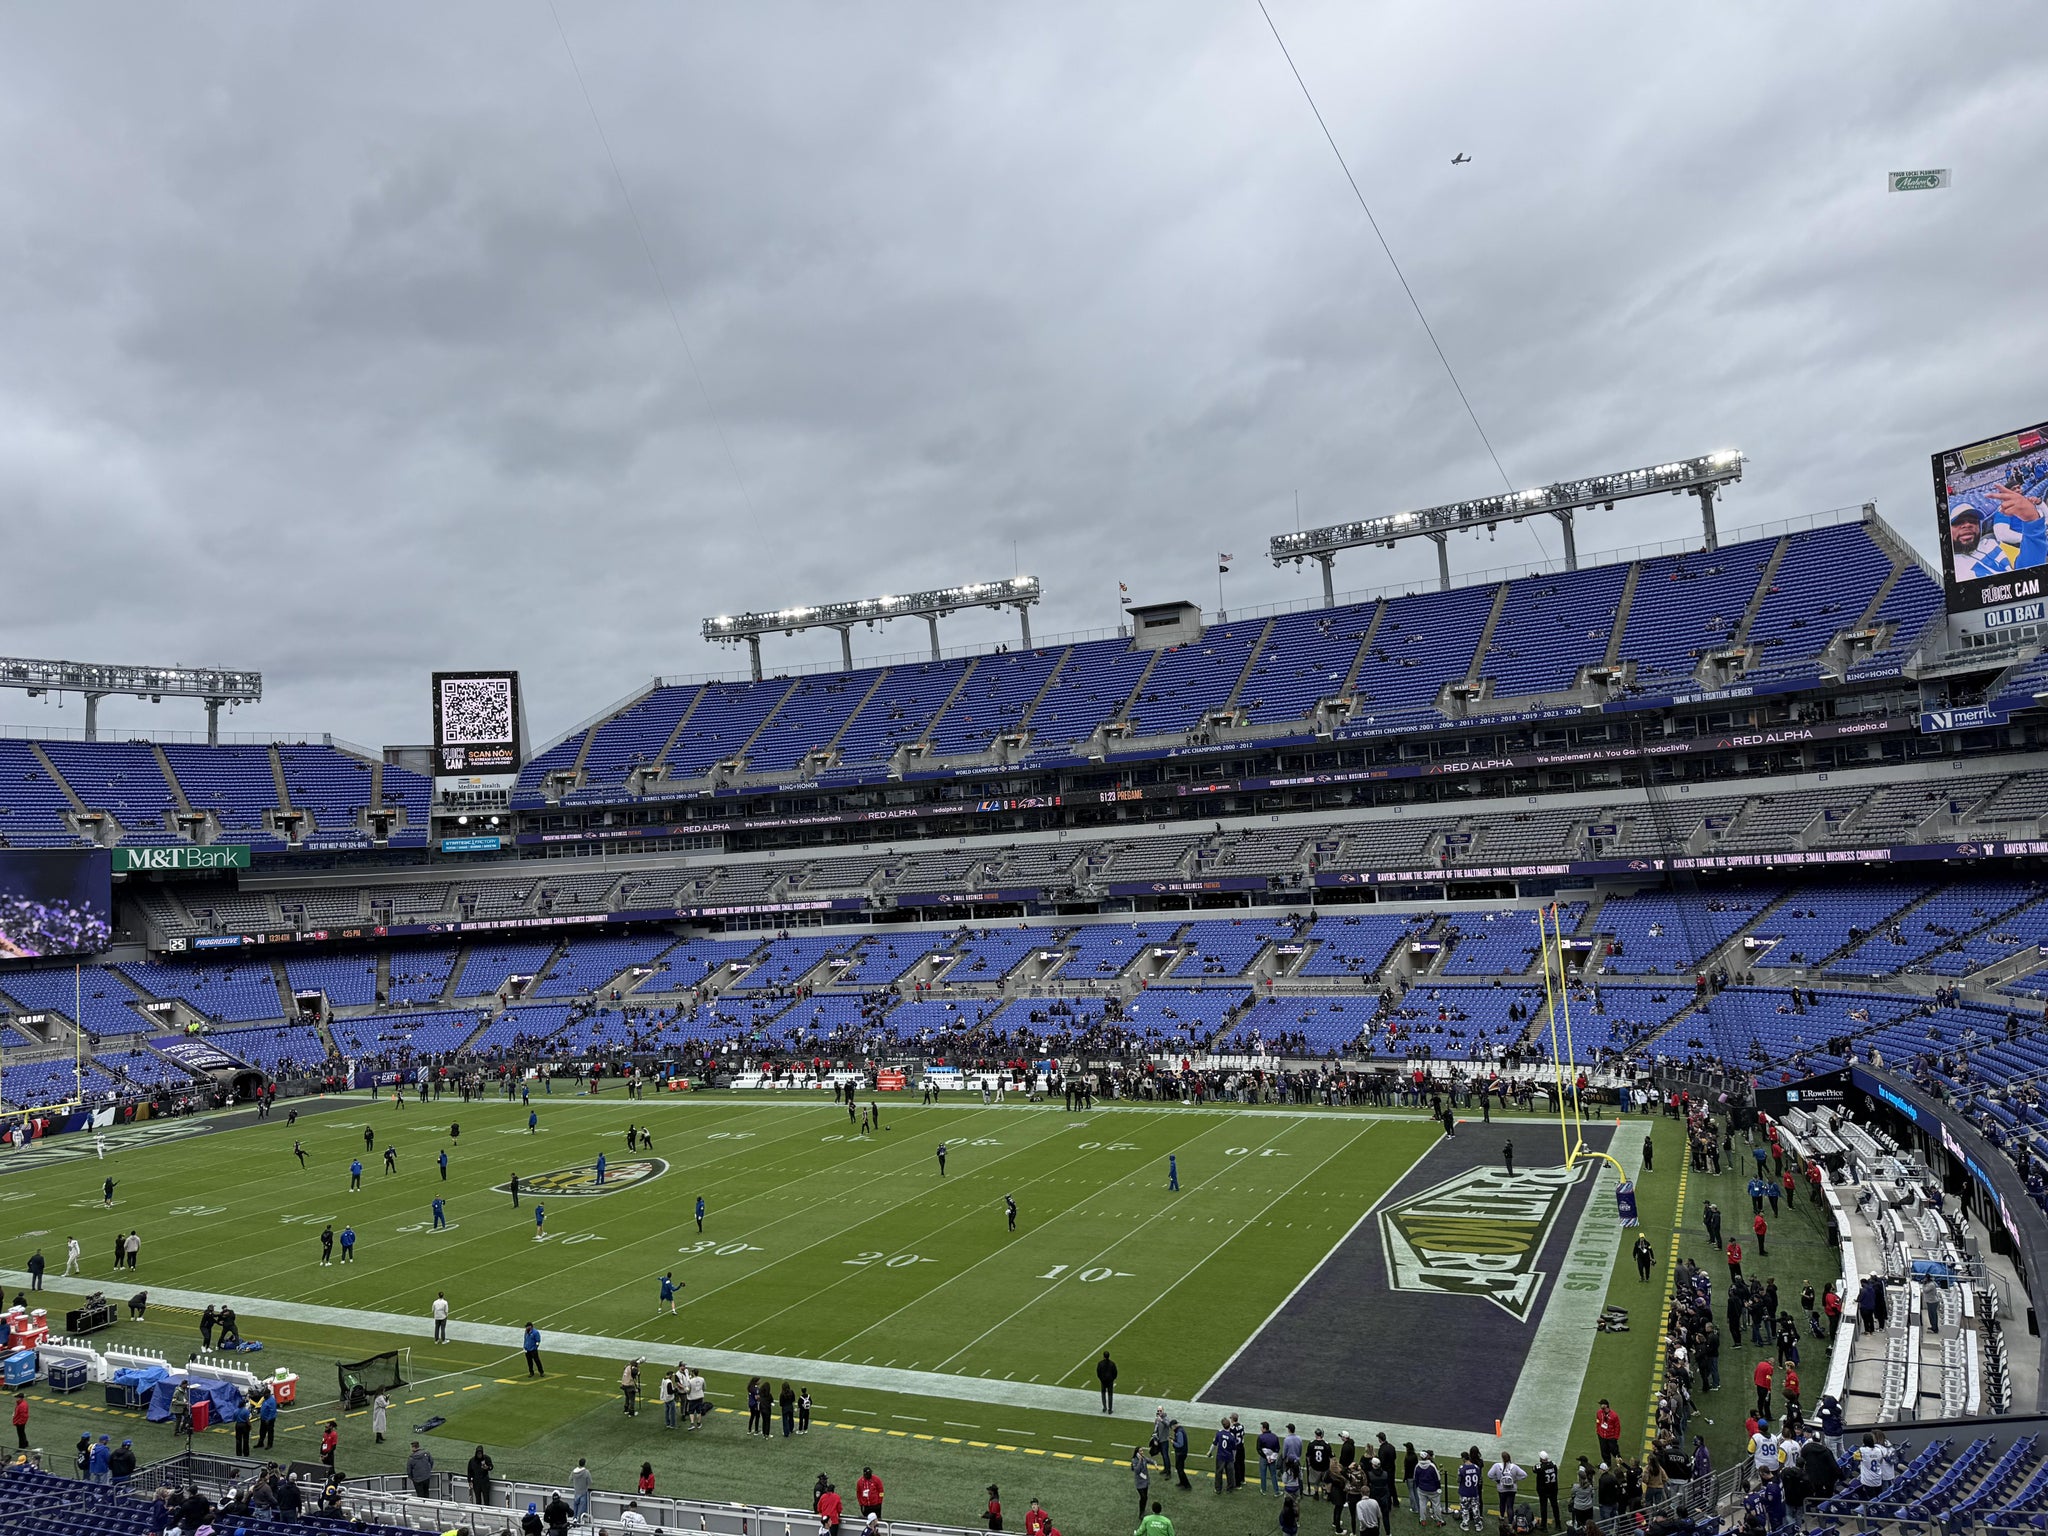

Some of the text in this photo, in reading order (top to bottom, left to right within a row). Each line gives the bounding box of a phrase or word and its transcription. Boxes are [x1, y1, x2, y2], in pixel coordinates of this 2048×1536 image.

[1982, 578, 2040, 604] FLOCK CAM
[1987, 604, 2040, 626] OLD BAY
[1846, 668, 1899, 680] RING HONOR
[1673, 696, 1690, 704] THANK
[1691, 694, 1702, 702] YOU
[1702, 692, 1730, 702] FRONTLINE
[1384, 726, 1418, 734] CHAMPIONS
[1564, 708, 1581, 716] 2024
[1733, 721, 1888, 746] RED ALPHA redalpha.ai
[468, 750, 492, 758] SCAN
[1192, 746, 1222, 754] CHAMPIONS
[1444, 762, 1469, 772] RED
[1472, 758, 1514, 770] ALPHA
[1550, 754, 1591, 762] Implement
[1644, 743, 1692, 754] Productivity.
[446, 759, 463, 770] CAM
[796, 782, 818, 790] HONOR
[1100, 790, 1143, 802] 61:23 PREGAME
[868, 812, 886, 820] RED
[888, 809, 918, 818] ALPHA
[702, 823, 730, 832] ALPHA
[2004, 842, 2028, 854] RAVENS
[127, 848, 238, 868] M&T Bank
[1673, 849, 1890, 868] RAVENS THANK THE SUPPORT OF THE BALTIMORE SMALL BUSINESS COMMUNITY
[1377, 865, 1570, 882] RAVENS THANK THE SUPPORT OF THE BALTIMORE SMALL BUSINESS COMMUNITY
[477, 922, 491, 930] THANK
[500, 920, 517, 928] SUPPORT
[531, 917, 553, 926] BALTIMORE
[585, 914, 608, 922] COMMUNITY
[196, 938, 238, 946] PROGRESSIVE
[257, 934, 264, 944] 10
[19, 1016, 30, 1024] OLD
[945, 1137, 998, 1146] 30
[1386, 1163, 1584, 1306] BALTIMORE
[678, 1240, 748, 1256] 30
[842, 1251, 919, 1268] 20
[1572, 1250, 1609, 1268] OF
[1036, 1264, 1113, 1282] 10
[1562, 1272, 1603, 1292] US
[279, 1384, 290, 1397] G
[1222, 1440, 1228, 1449] 0
[1762, 1444, 1776, 1456] 99
[1315, 1450, 1322, 1462] 8
[1870, 1460, 1878, 1472] 8
[1465, 1474, 1478, 1487] 89
[1545, 1473, 1556, 1484] 32
